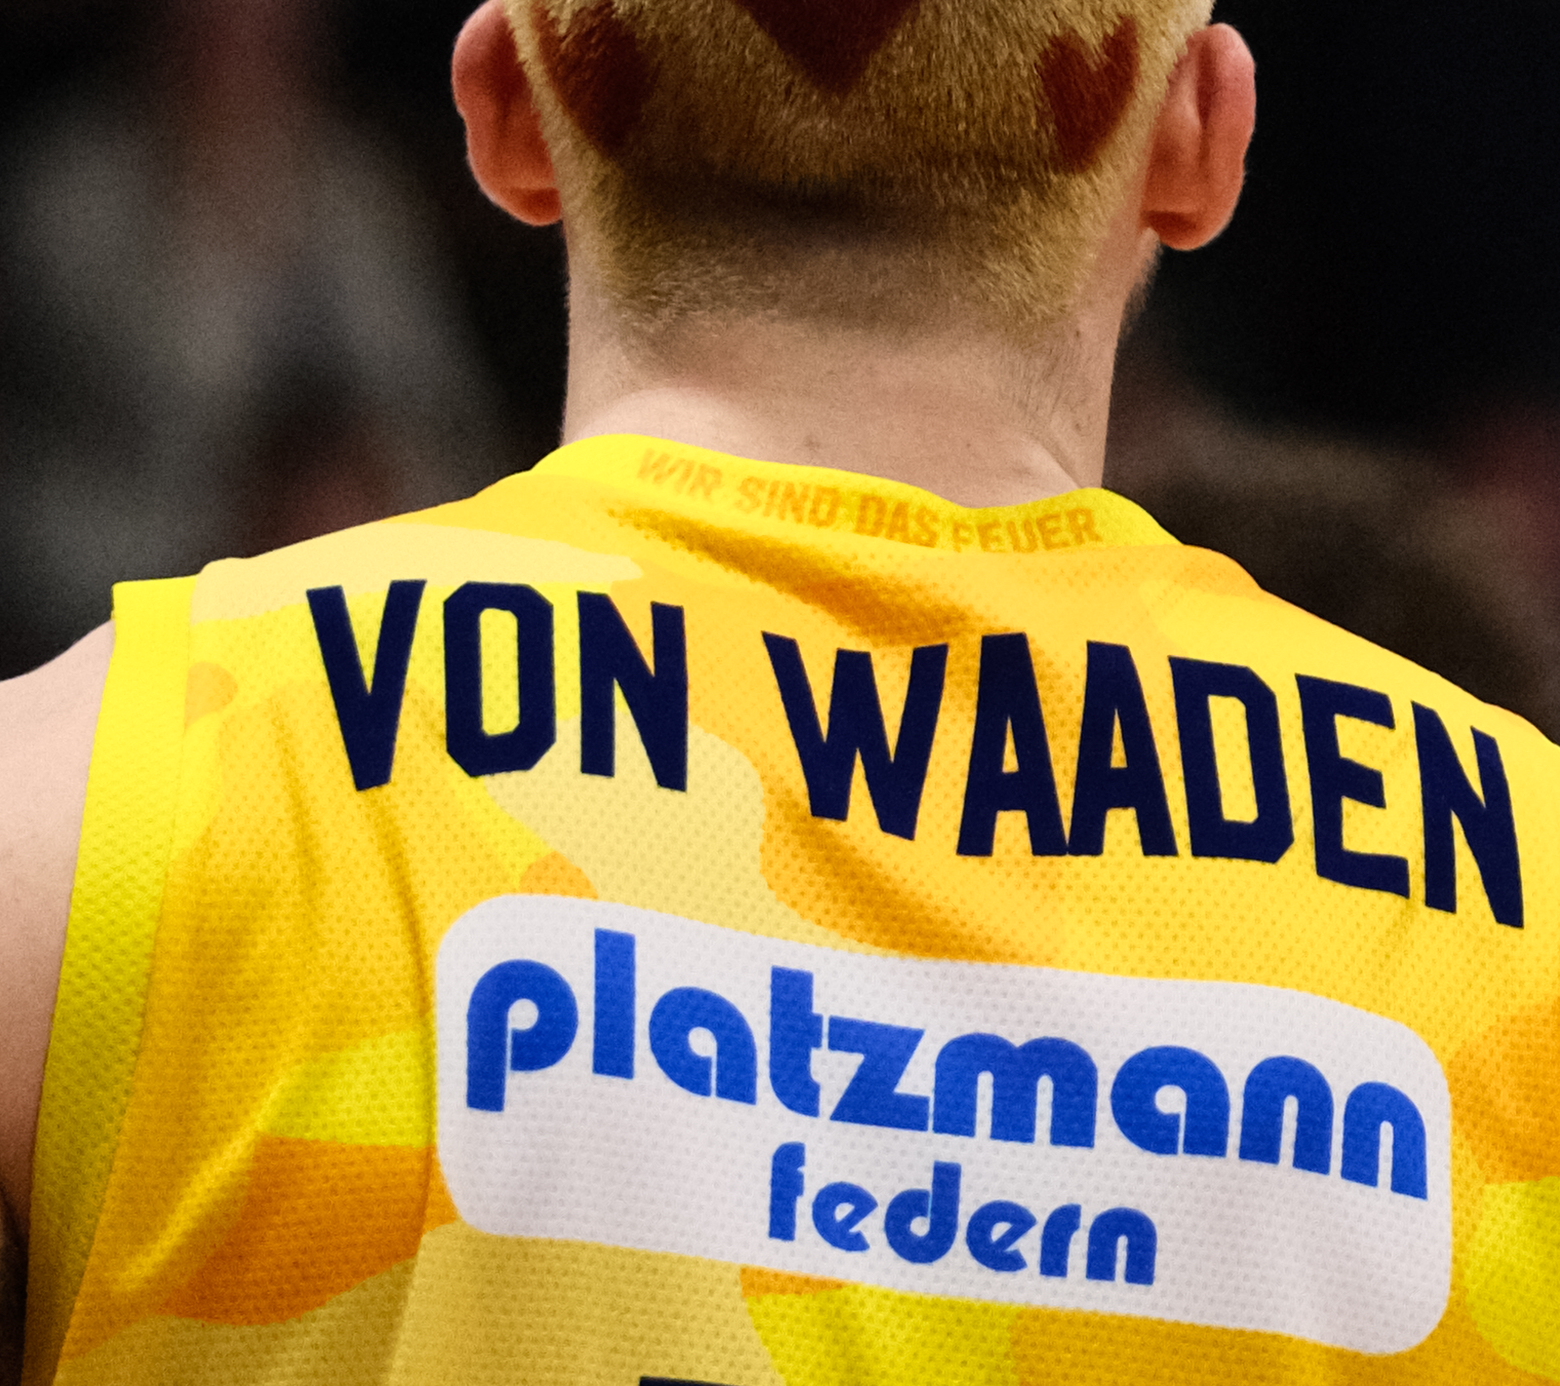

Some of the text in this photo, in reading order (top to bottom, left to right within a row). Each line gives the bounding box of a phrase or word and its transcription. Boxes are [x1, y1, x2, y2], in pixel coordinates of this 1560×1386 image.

[636, 446, 1104, 554] WIR SIND DAS FEUER
[306, 580, 1527, 929] VON WAADEN
[466, 927, 1430, 1202] platzmann
[768, 1143, 1158, 1289] federn
